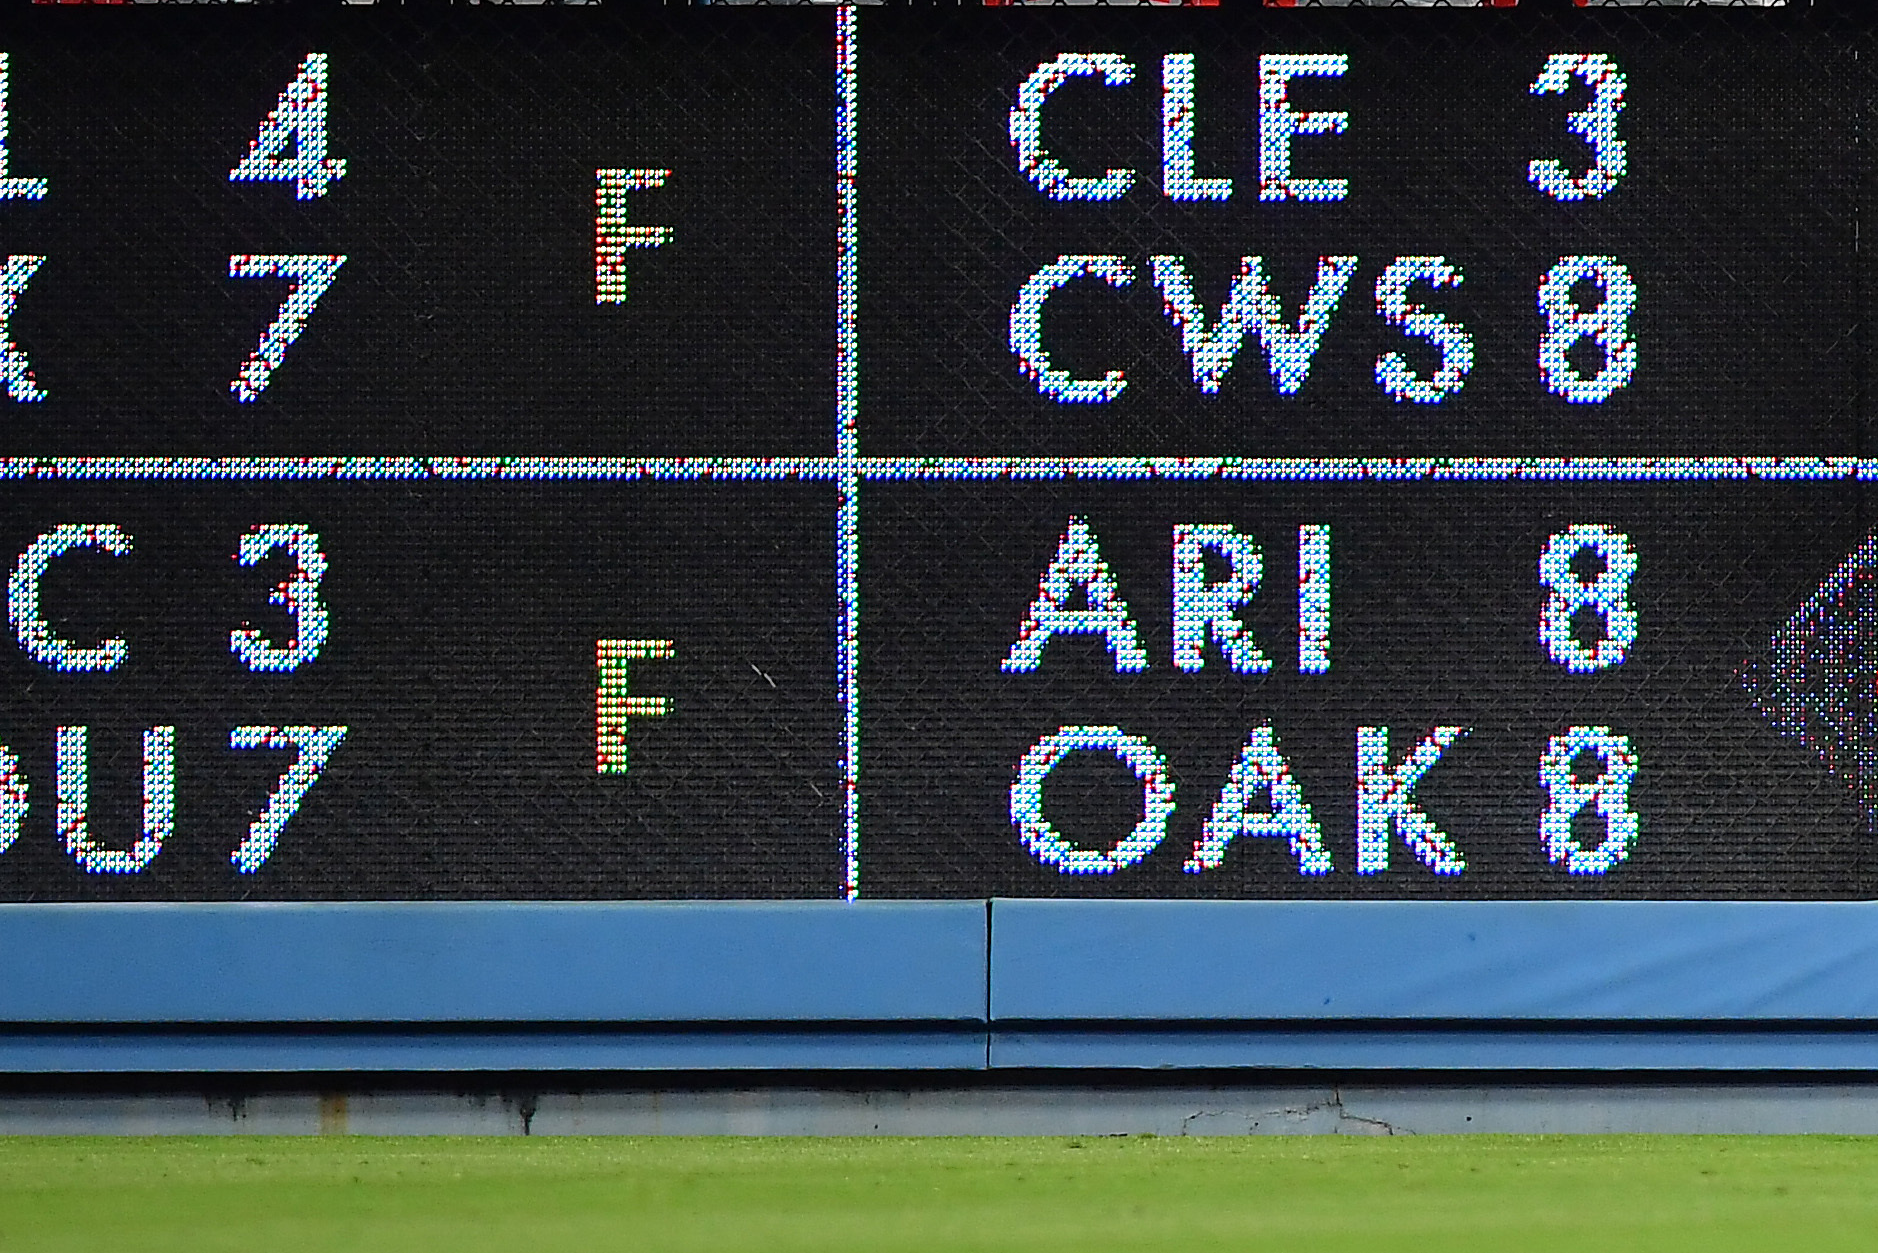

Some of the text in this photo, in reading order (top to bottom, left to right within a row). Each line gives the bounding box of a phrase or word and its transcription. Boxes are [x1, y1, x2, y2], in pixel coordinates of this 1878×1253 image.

[229, 53, 347, 201] 4
[1008, 53, 1628, 202] CLE 3
[596, 168, 674, 305] F
[229, 255, 348, 403] 7
[1009, 255, 1637, 405] CWS 8
[8, 524, 329, 672] C 3
[1001, 515, 1638, 675] ARI 8
[596, 640, 674, 774] F
[0, 725, 348, 874] U 7
[1009, 718, 1638, 876] OAK 8
